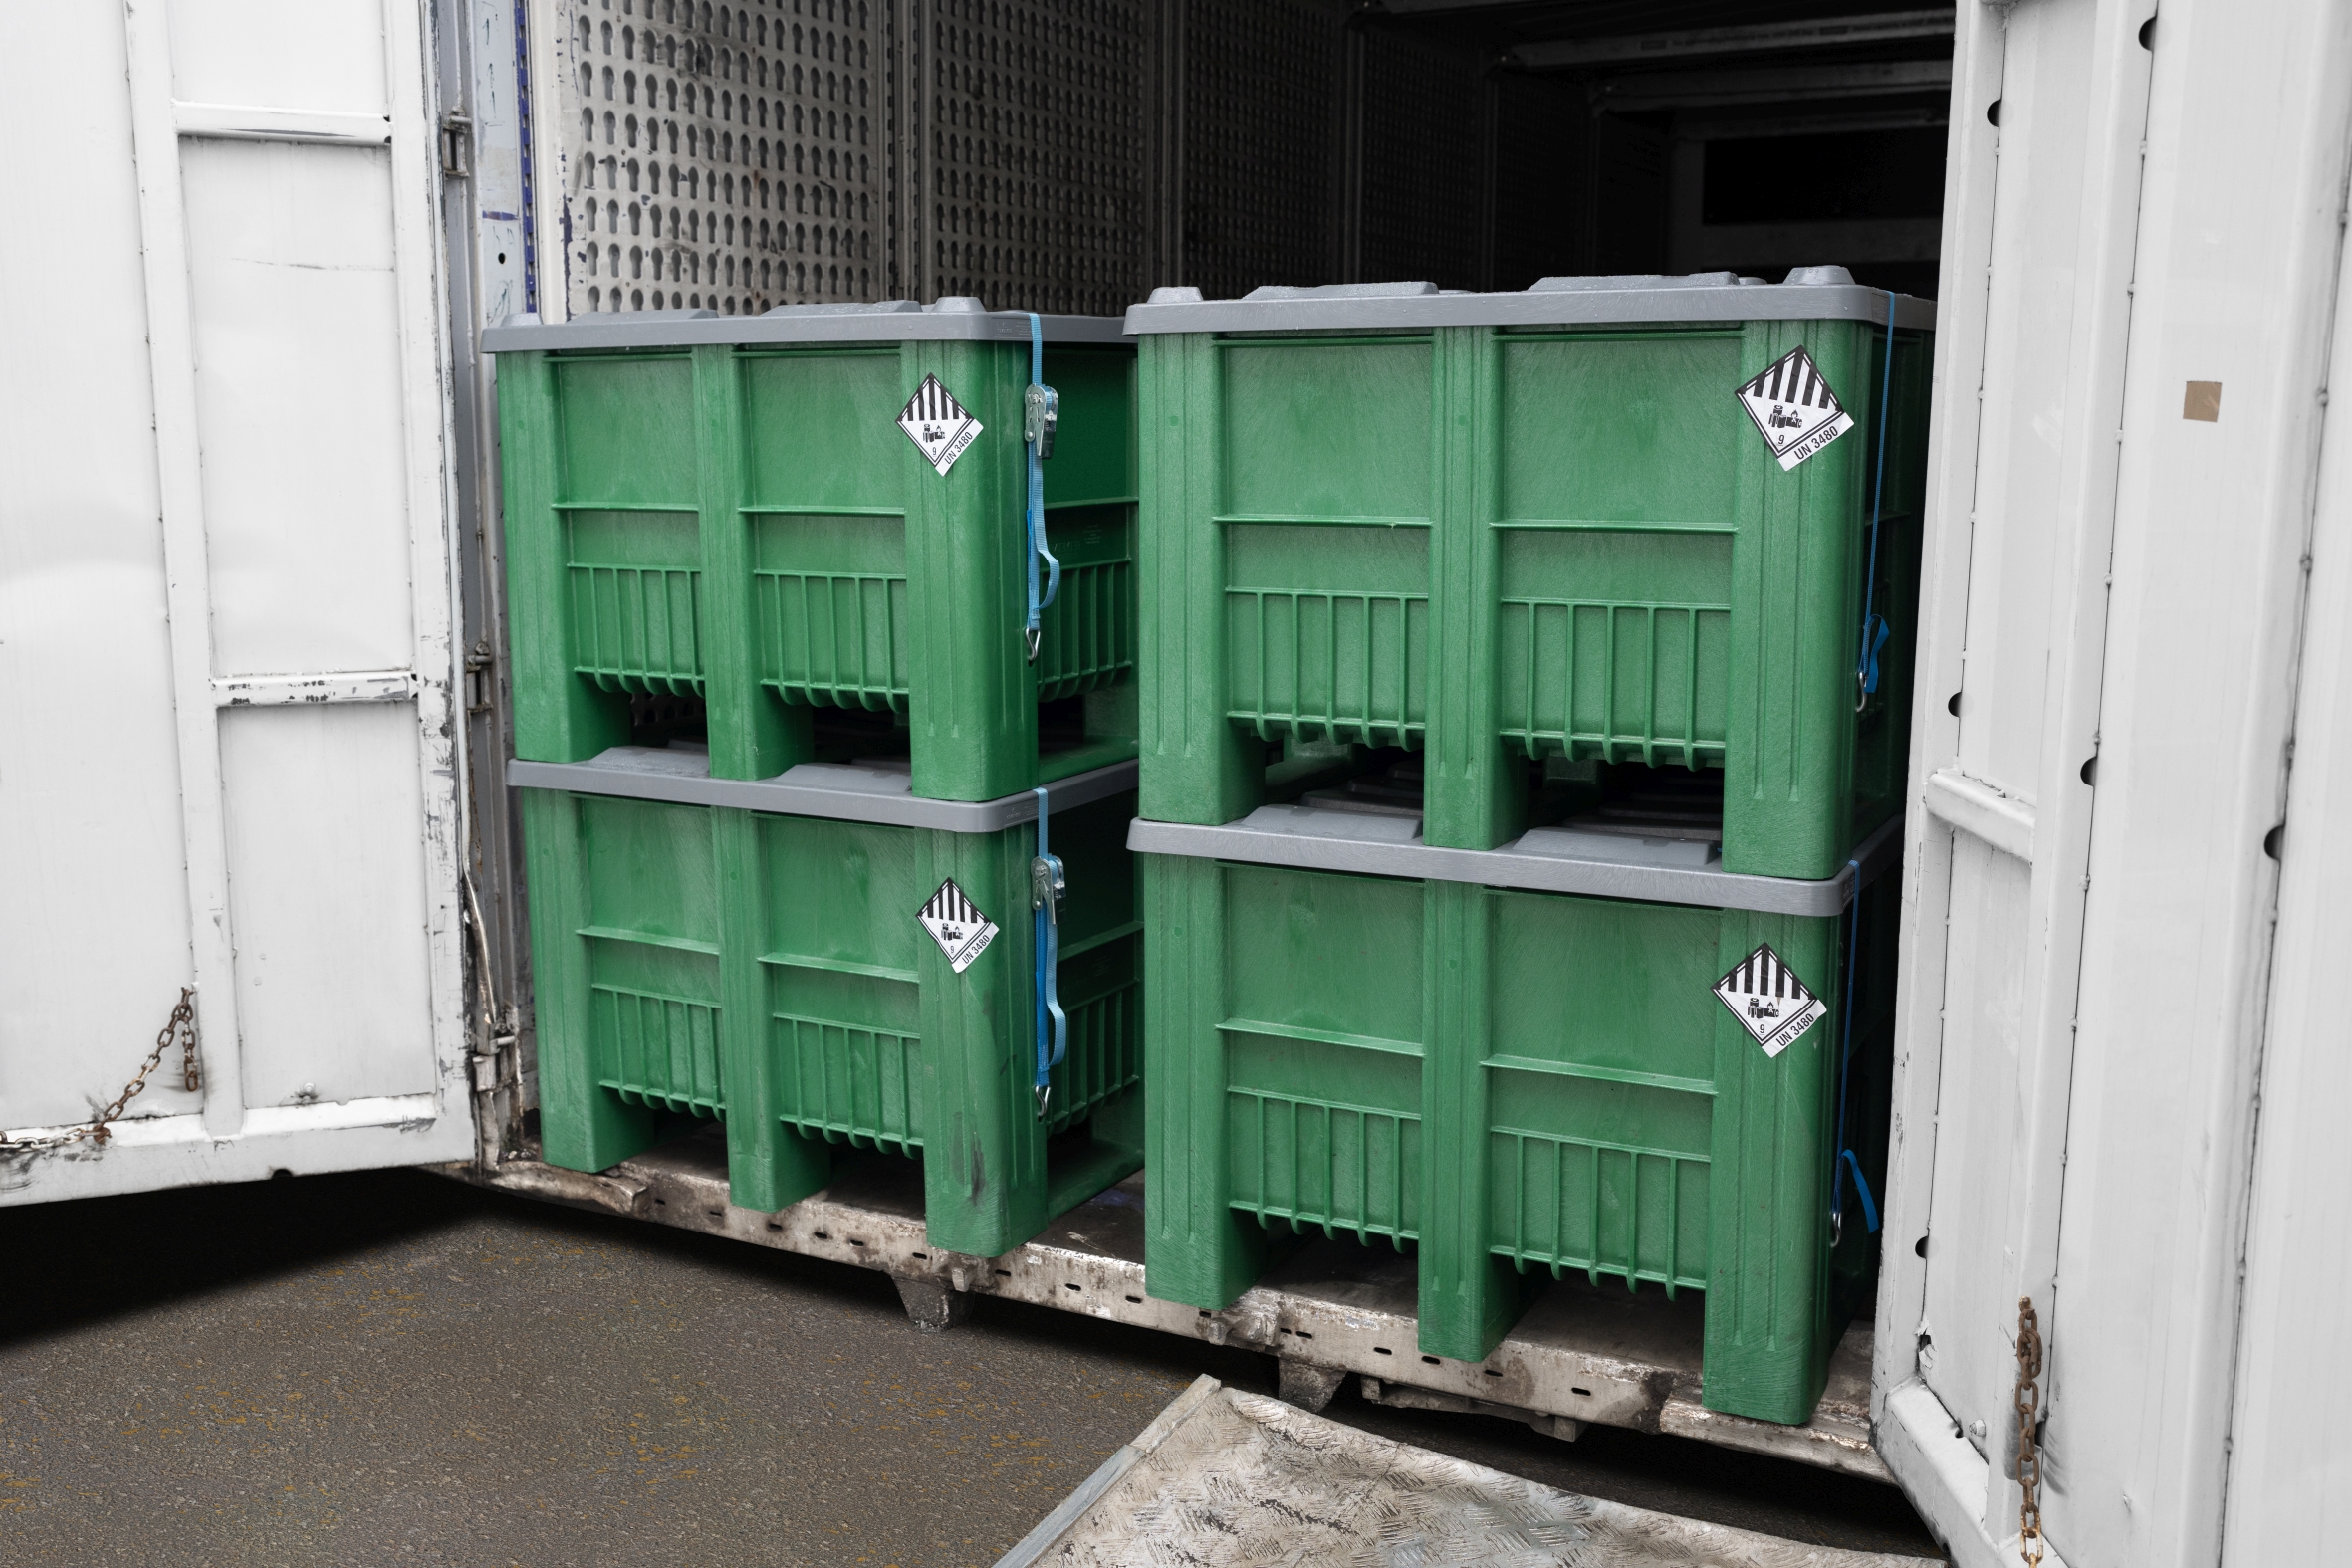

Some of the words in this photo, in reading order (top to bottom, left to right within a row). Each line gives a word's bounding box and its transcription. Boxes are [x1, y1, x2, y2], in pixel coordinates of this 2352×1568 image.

[945, 450, 957, 465] UN
[954, 431, 974, 453] 3480
[1778, 434, 1785, 445] 9
[1794, 443, 1812, 460] UN
[1811, 425, 1839, 449] 3480
[962, 951, 974, 964] UN
[971, 934, 991, 955] 3480
[1760, 1023, 1765, 1034] 9
[1775, 1031, 1793, 1047] UN
[1790, 1013, 1815, 1036] 3480
